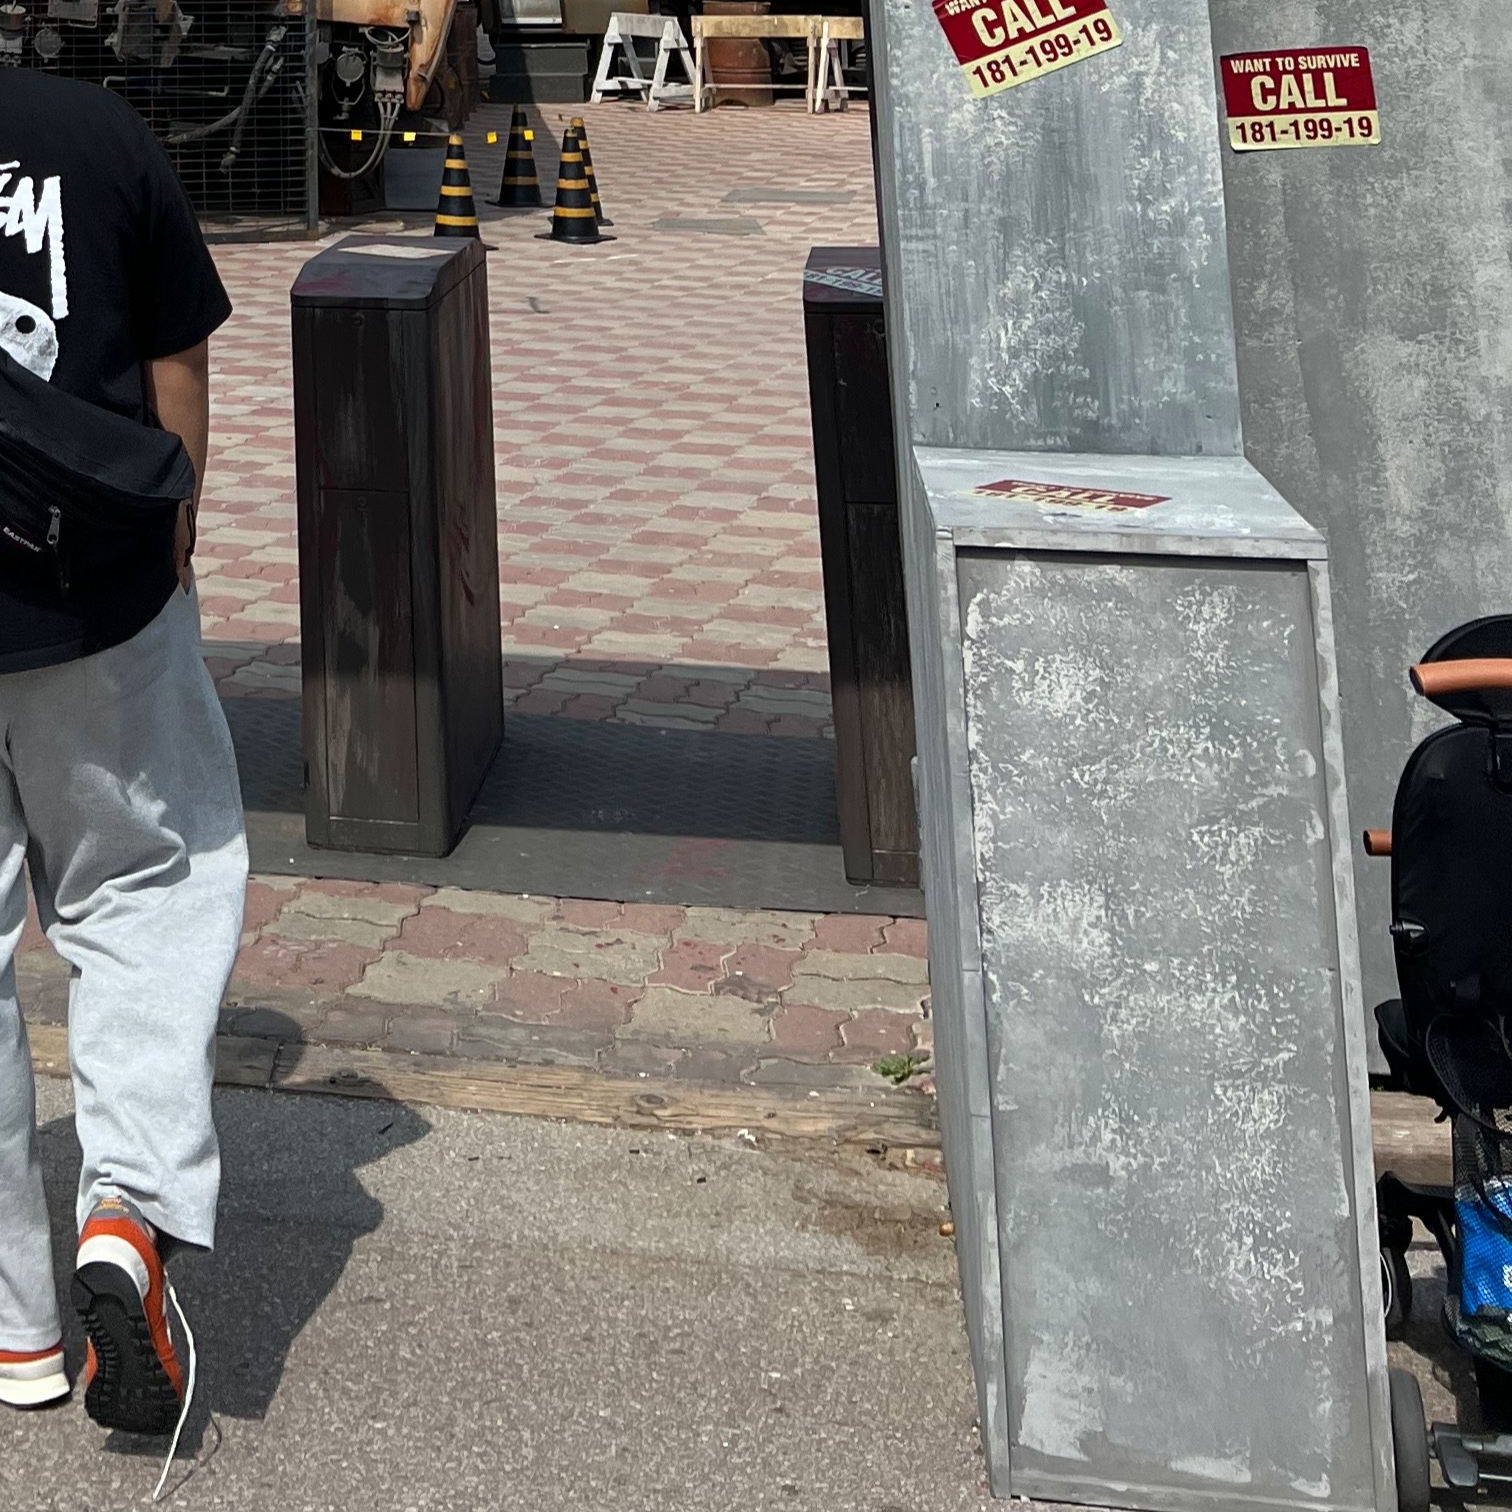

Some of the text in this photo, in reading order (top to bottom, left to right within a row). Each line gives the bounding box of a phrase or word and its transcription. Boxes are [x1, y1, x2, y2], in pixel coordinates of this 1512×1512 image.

[972, 18, 1113, 88] 181-199-19
[1230, 53, 1360, 74] WANT TO SURVIVE
[1250, 72, 1347, 111] CALL
[1236, 116, 1373, 143] 181-199-19
